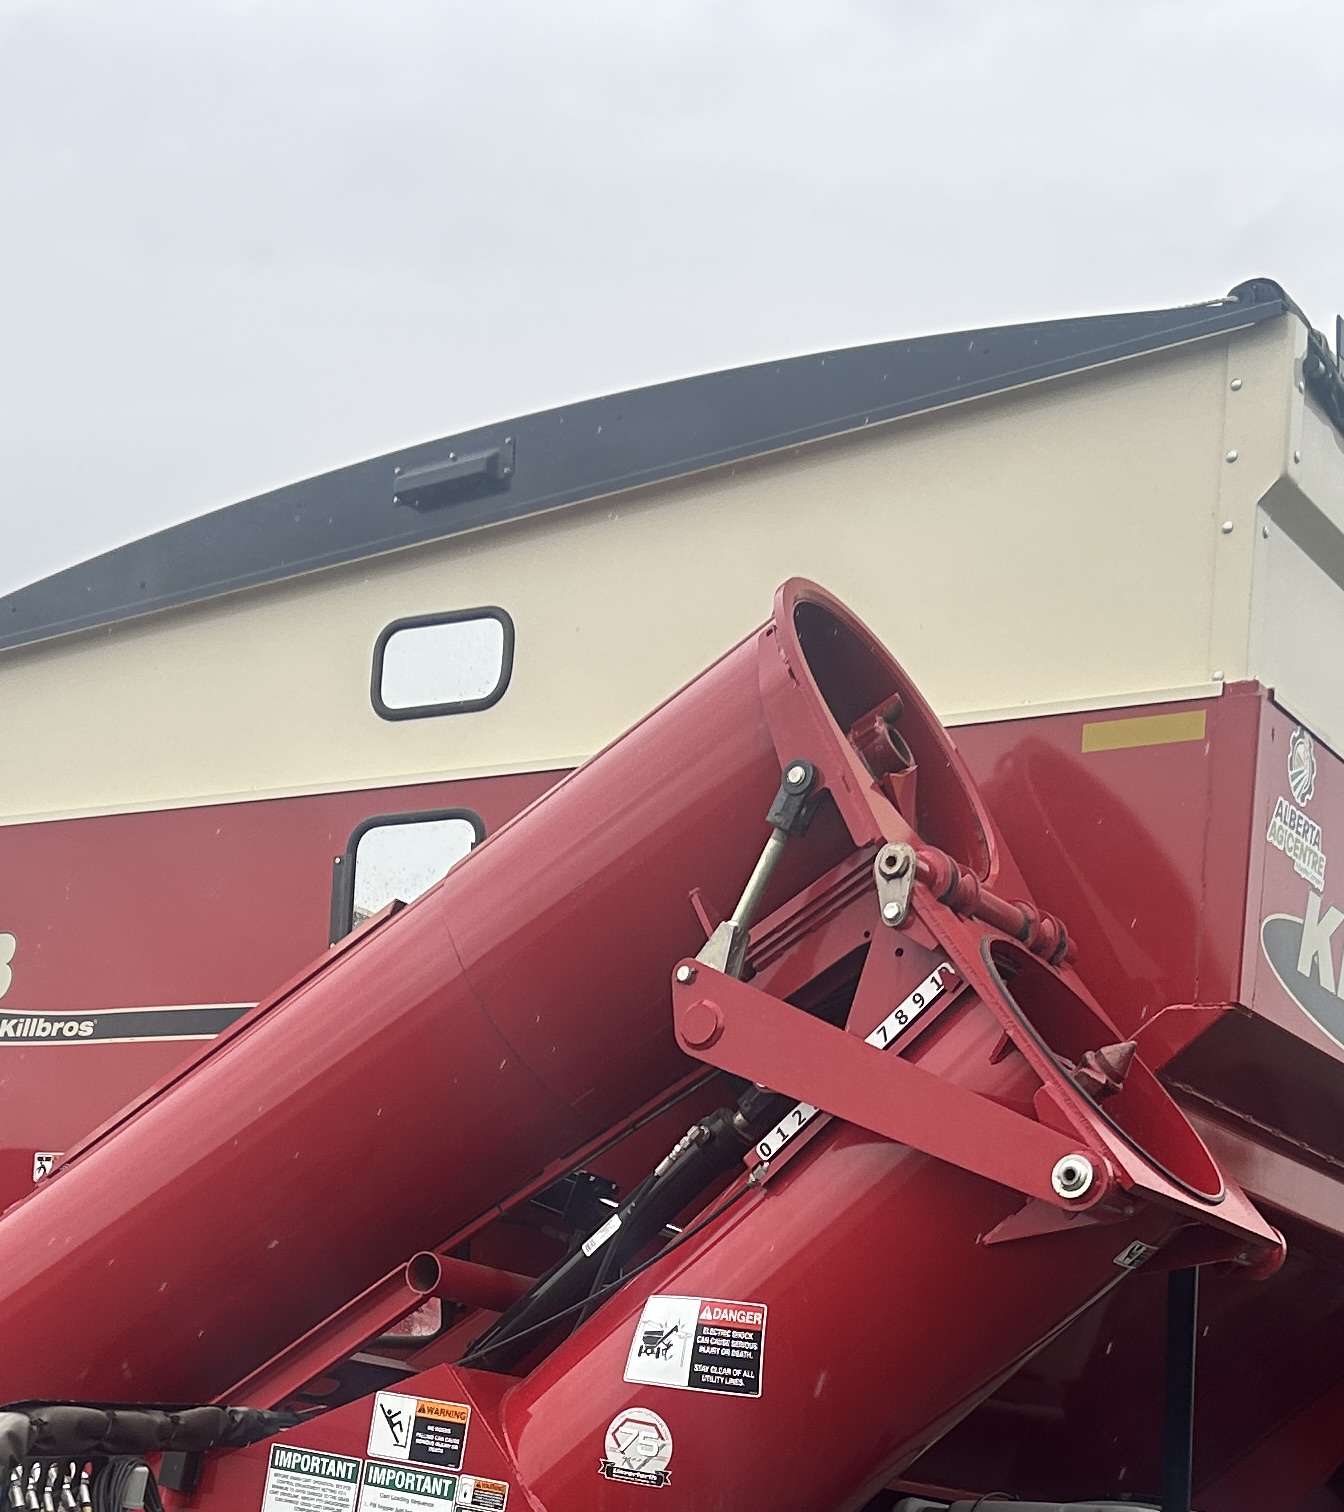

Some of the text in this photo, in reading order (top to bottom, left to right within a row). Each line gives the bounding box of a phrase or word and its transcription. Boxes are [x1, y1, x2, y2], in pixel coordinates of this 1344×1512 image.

[1275, 800, 1321, 849] ALBERTA
[876, 1026, 889, 1043] 7
[895, 1010, 909, 1025] 8
[912, 993, 925, 1009] 9
[759, 1143, 772, 1157] 0
[713, 1307, 762, 1325] DANGER
[426, 1406, 467, 1421] WARNING
[618, 1426, 660, 1457] 75
[274, 1449, 356, 1480] IMPORTANT
[367, 1465, 452, 1497] IMPORTANT
